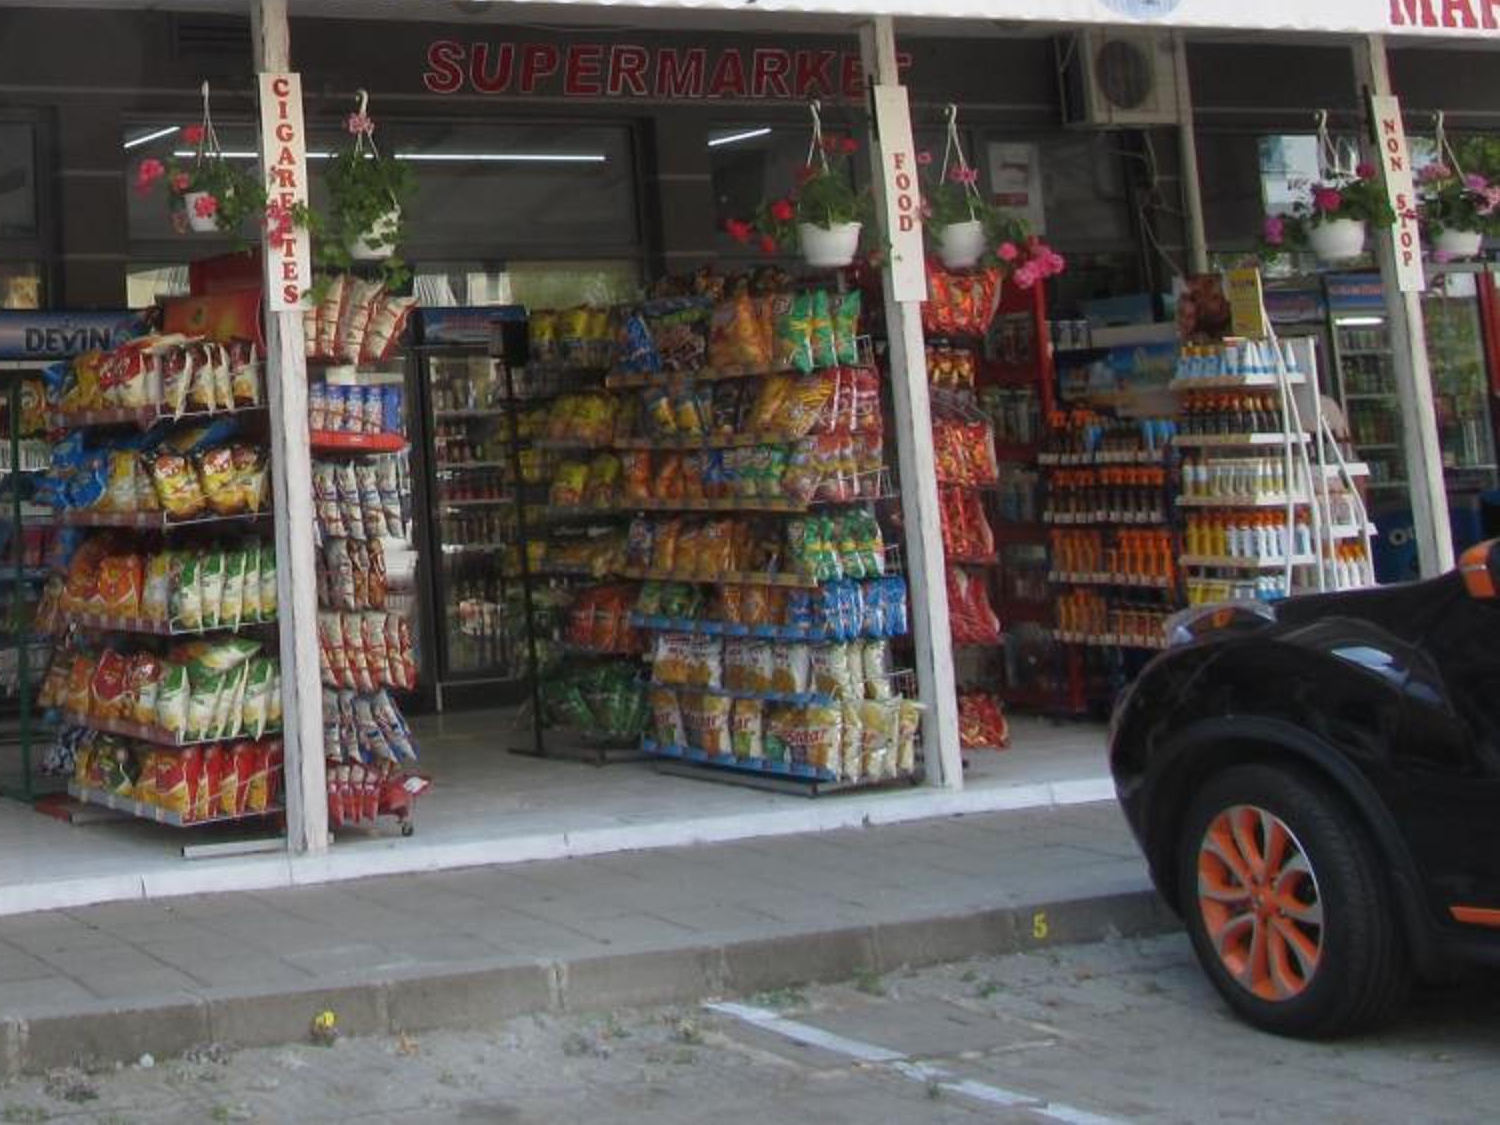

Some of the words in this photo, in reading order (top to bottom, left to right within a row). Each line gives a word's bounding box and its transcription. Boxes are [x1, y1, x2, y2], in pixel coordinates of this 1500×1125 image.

[1383, 119, 1403, 172] NON
[892, 152, 914, 233] FOOD
[24, 327, 111, 353] DEVIN
[1033, 912, 1048, 940] 5
